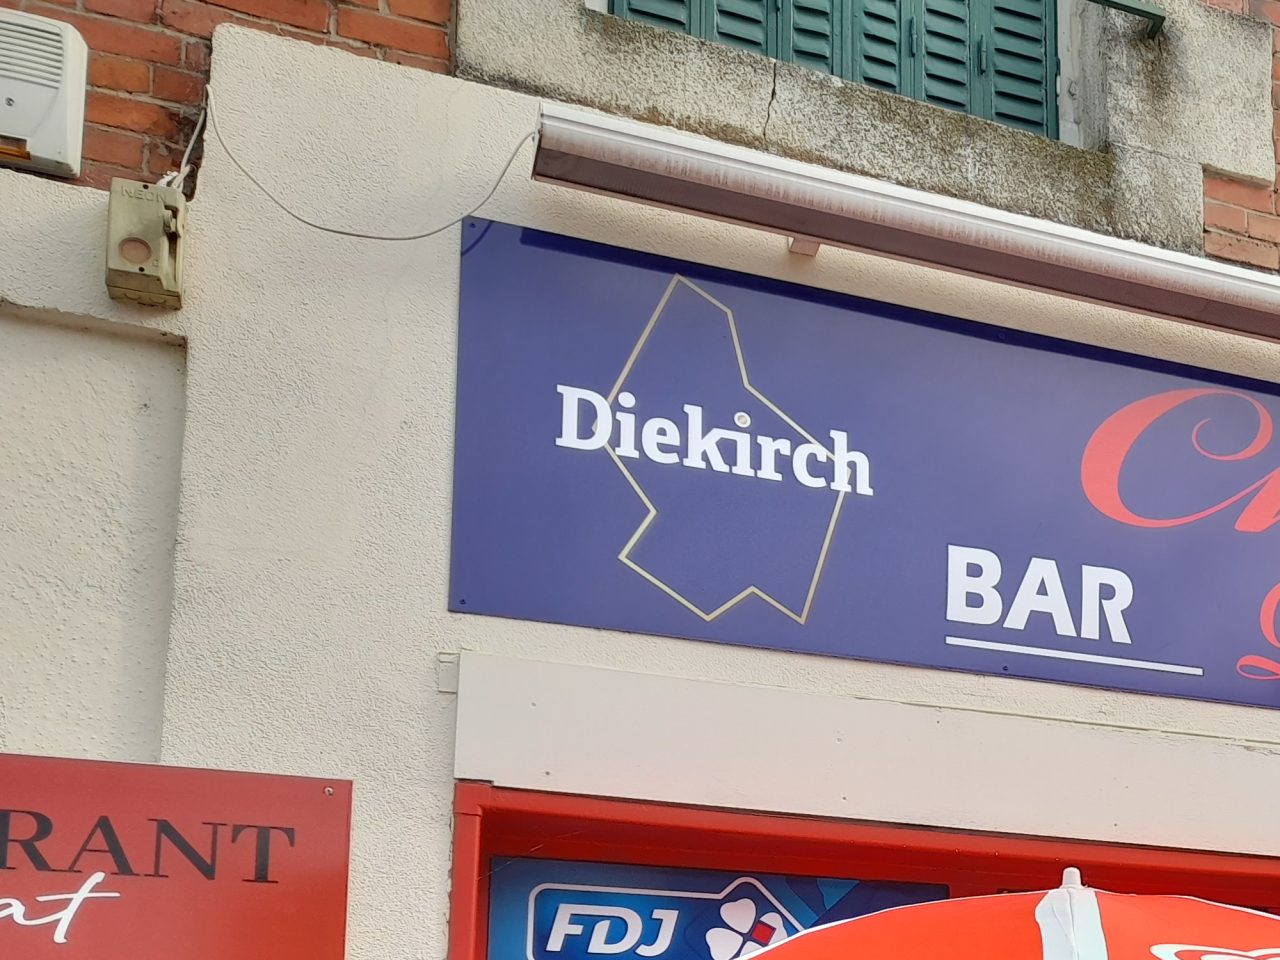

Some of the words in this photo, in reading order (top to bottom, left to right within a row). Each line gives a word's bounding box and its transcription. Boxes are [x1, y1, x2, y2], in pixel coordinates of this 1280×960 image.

[556, 384, 873, 495] Diekirch
[946, 544, 1135, 644] BAR
[0, 808, 295, 884] RANT
[546, 903, 680, 957] FDJ
